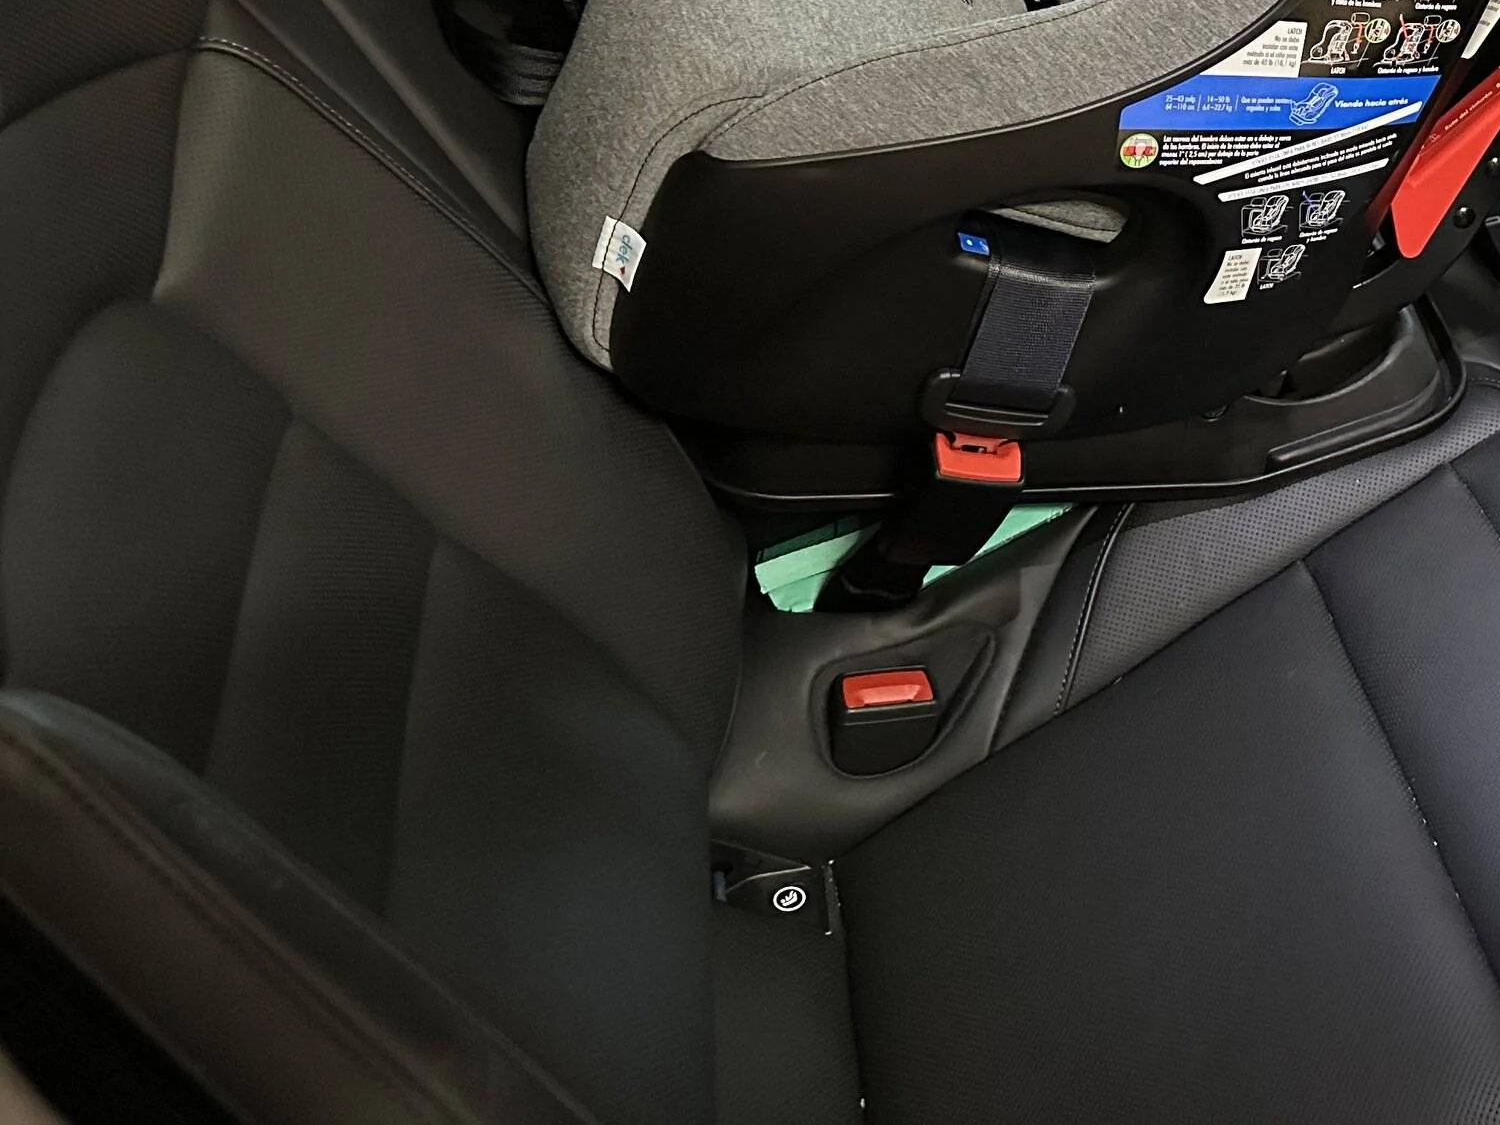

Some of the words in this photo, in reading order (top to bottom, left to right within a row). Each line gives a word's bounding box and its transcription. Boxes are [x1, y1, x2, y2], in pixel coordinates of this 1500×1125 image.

[1364, 98, 1386, 106] hacia
[1387, 96, 1408, 105] atrás
[616, 234, 633, 264] clek
